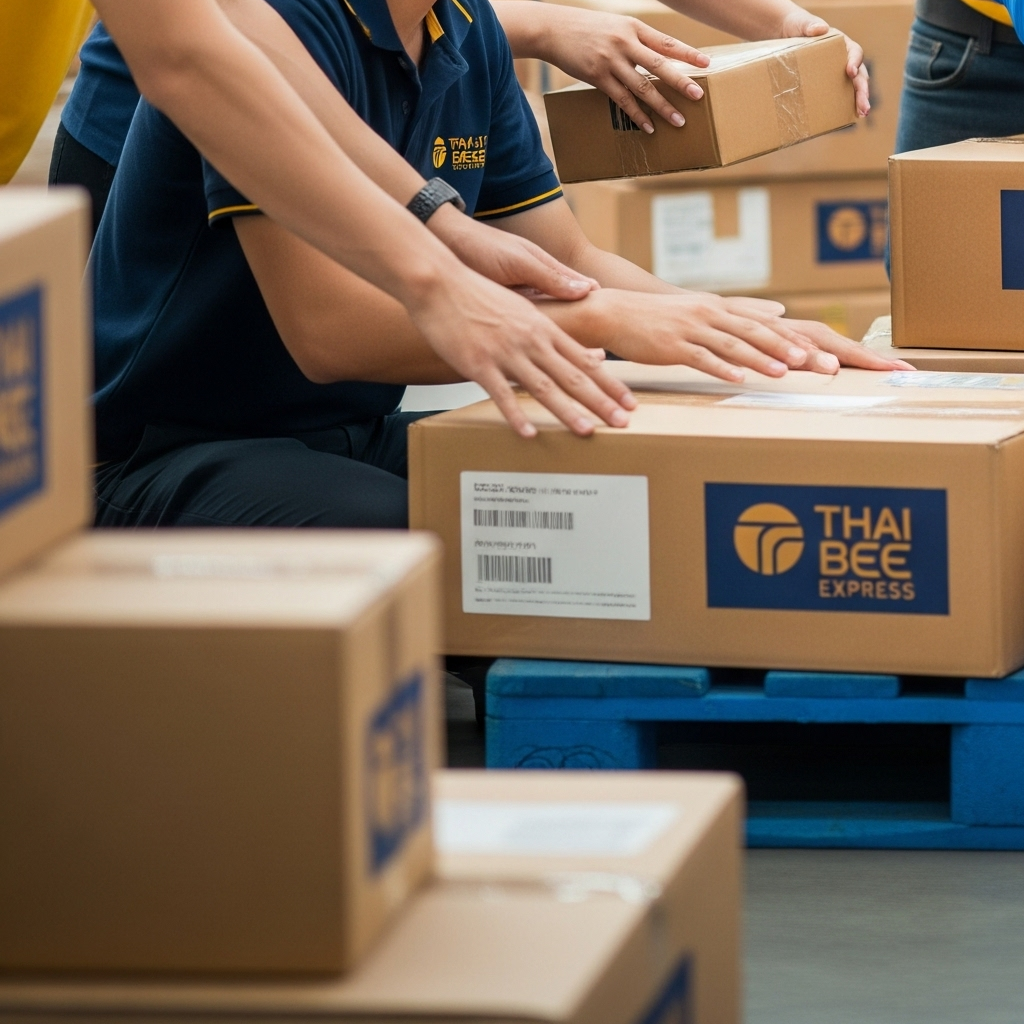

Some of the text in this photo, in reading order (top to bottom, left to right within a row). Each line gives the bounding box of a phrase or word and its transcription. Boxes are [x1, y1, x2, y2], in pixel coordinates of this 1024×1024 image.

[814, 505, 912, 541] THAI
[819, 540, 912, 580] BEE
[818, 579, 915, 601] EXPRESS
